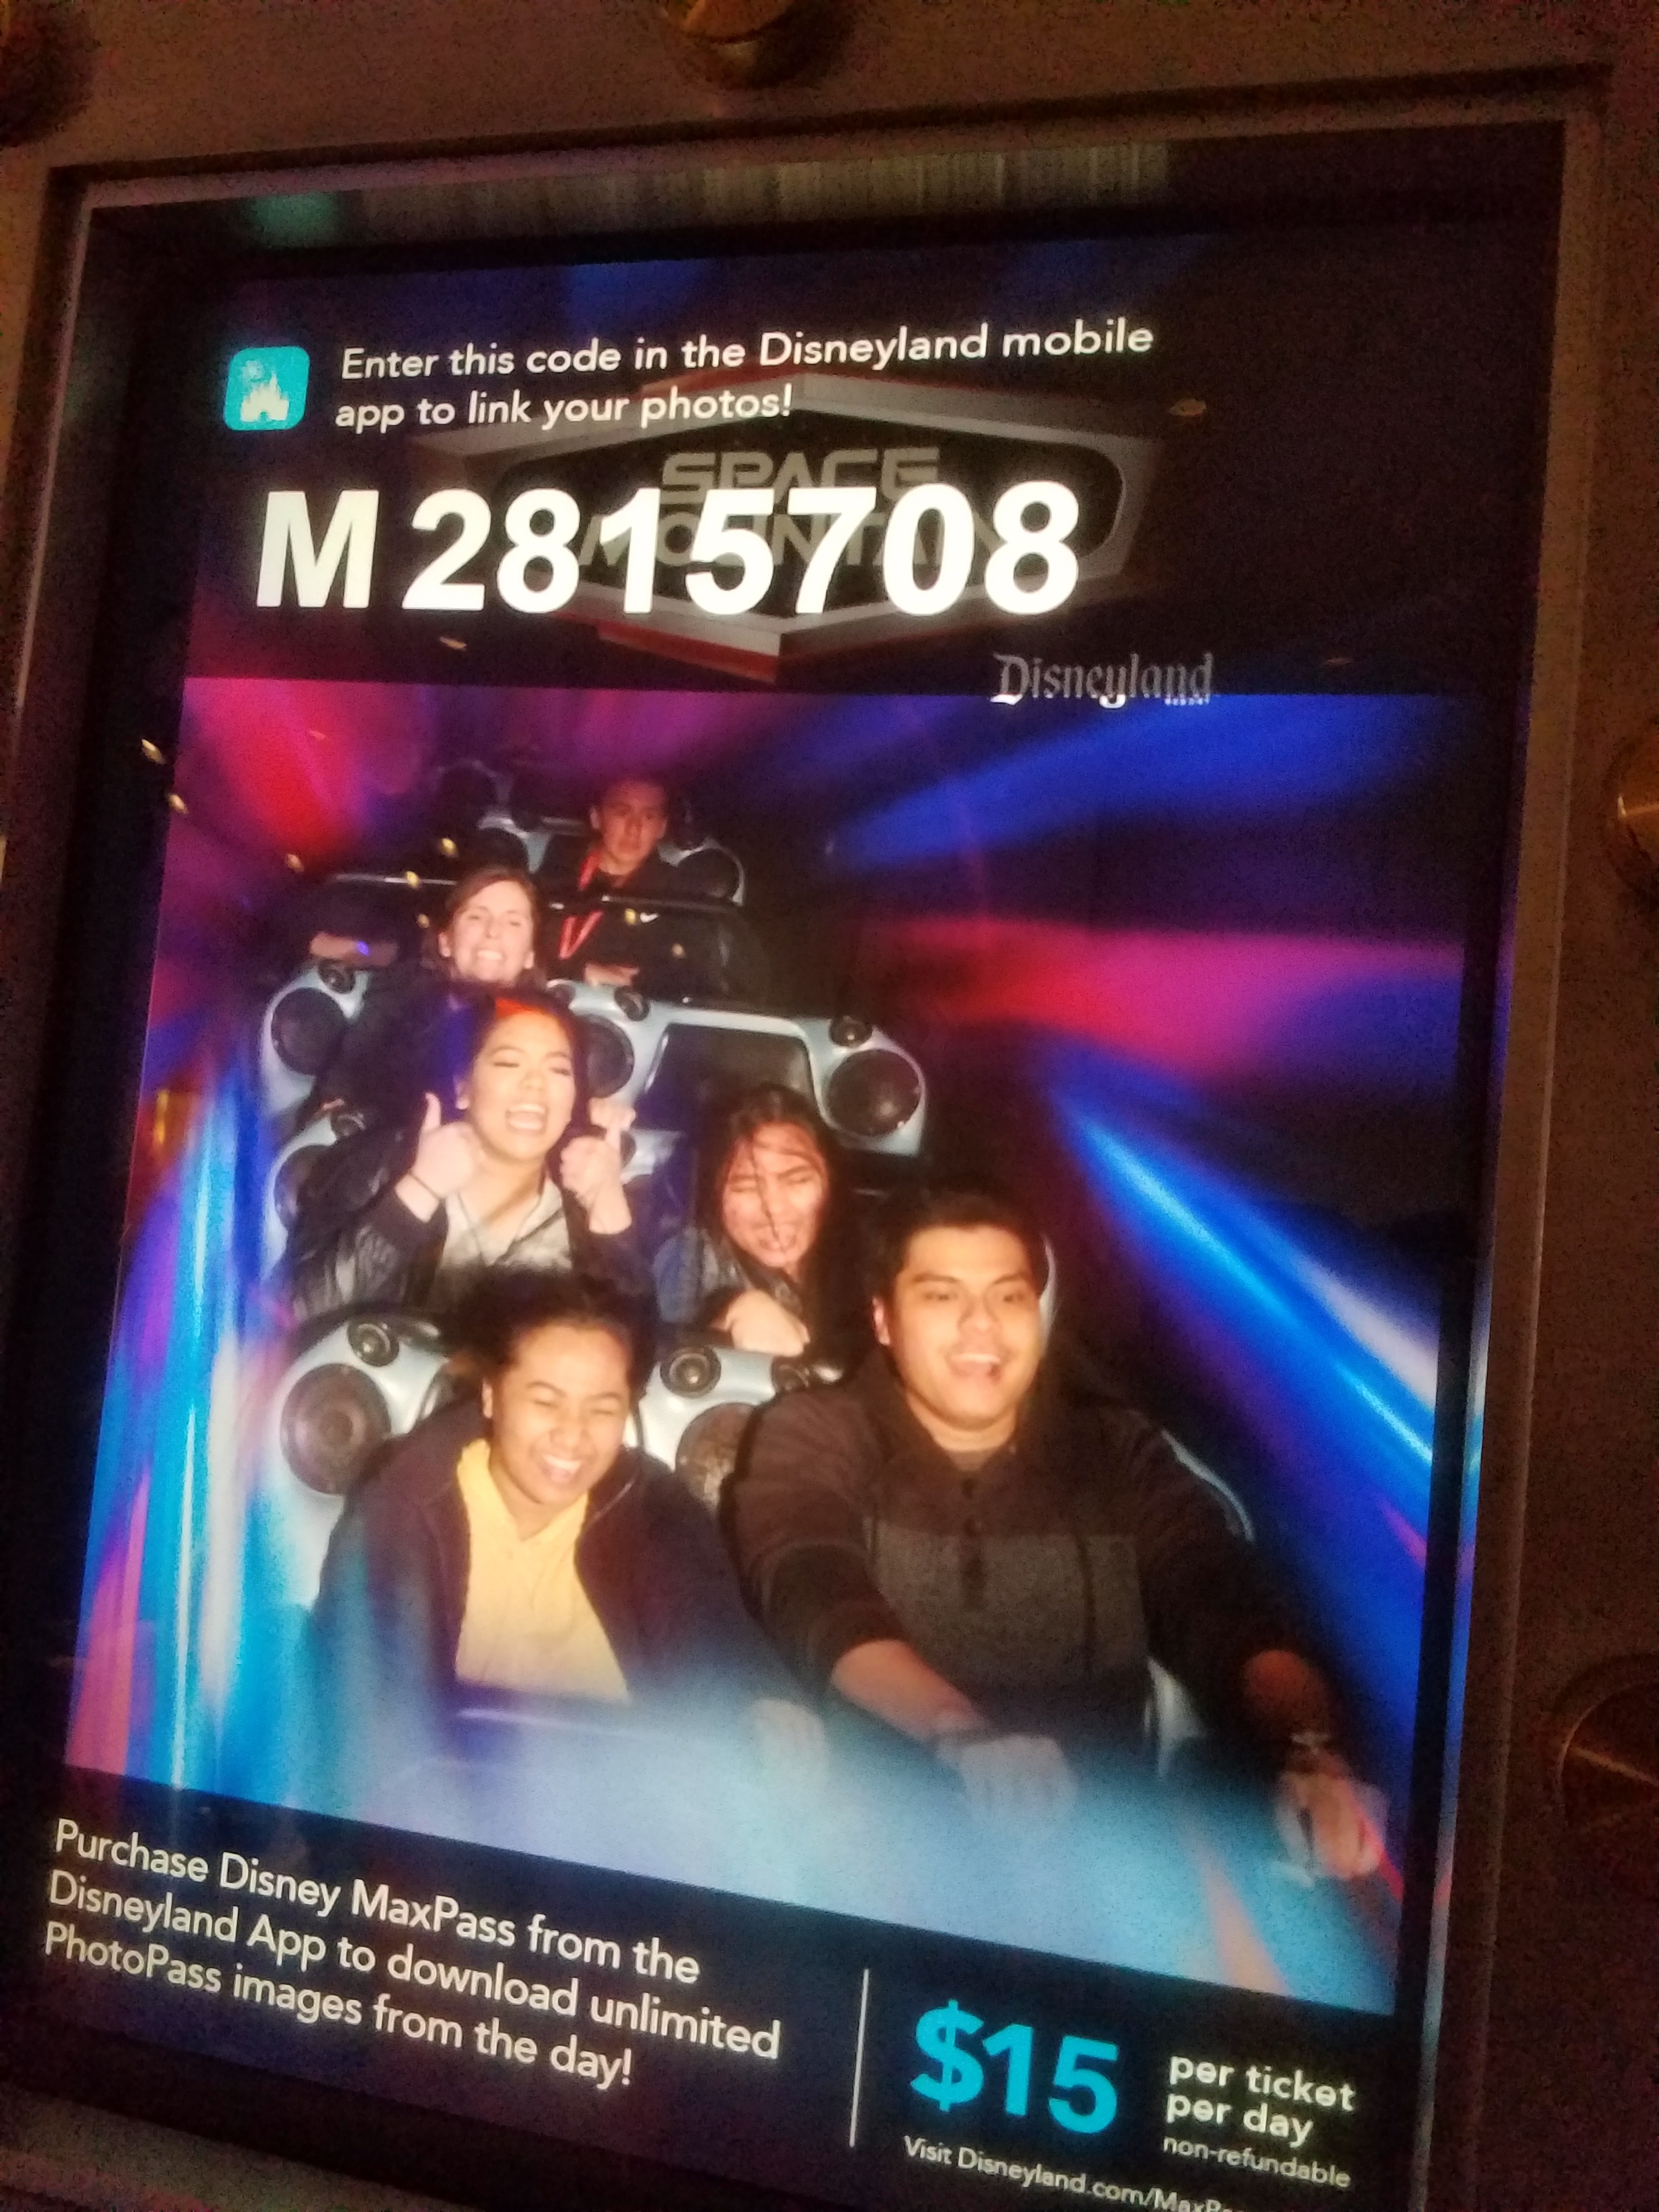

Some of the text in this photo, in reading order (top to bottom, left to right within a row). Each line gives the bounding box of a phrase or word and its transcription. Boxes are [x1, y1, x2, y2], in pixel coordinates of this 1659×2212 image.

[342, 318, 1154, 379] Enter this code in the Disneyland mobile
[335, 383, 793, 433] app to link your photos!
[256, 481, 1079, 615] M 2815708
[990, 652, 1214, 709] Disneyland
[55, 1818, 700, 1984] Purchase Disney MaxPass from the
[49, 1868, 781, 2059] Disneyland App to download unlimited
[44, 1921, 632, 2091] PhotoPass images from the day!
[910, 1999, 1119, 2135] $15
[1169, 2055, 1357, 2112] per ticket
[903, 2135, 952, 2165] Visit
[1165, 2092, 1314, 2149] per day
[1163, 2136, 1352, 2189] non-refundable
